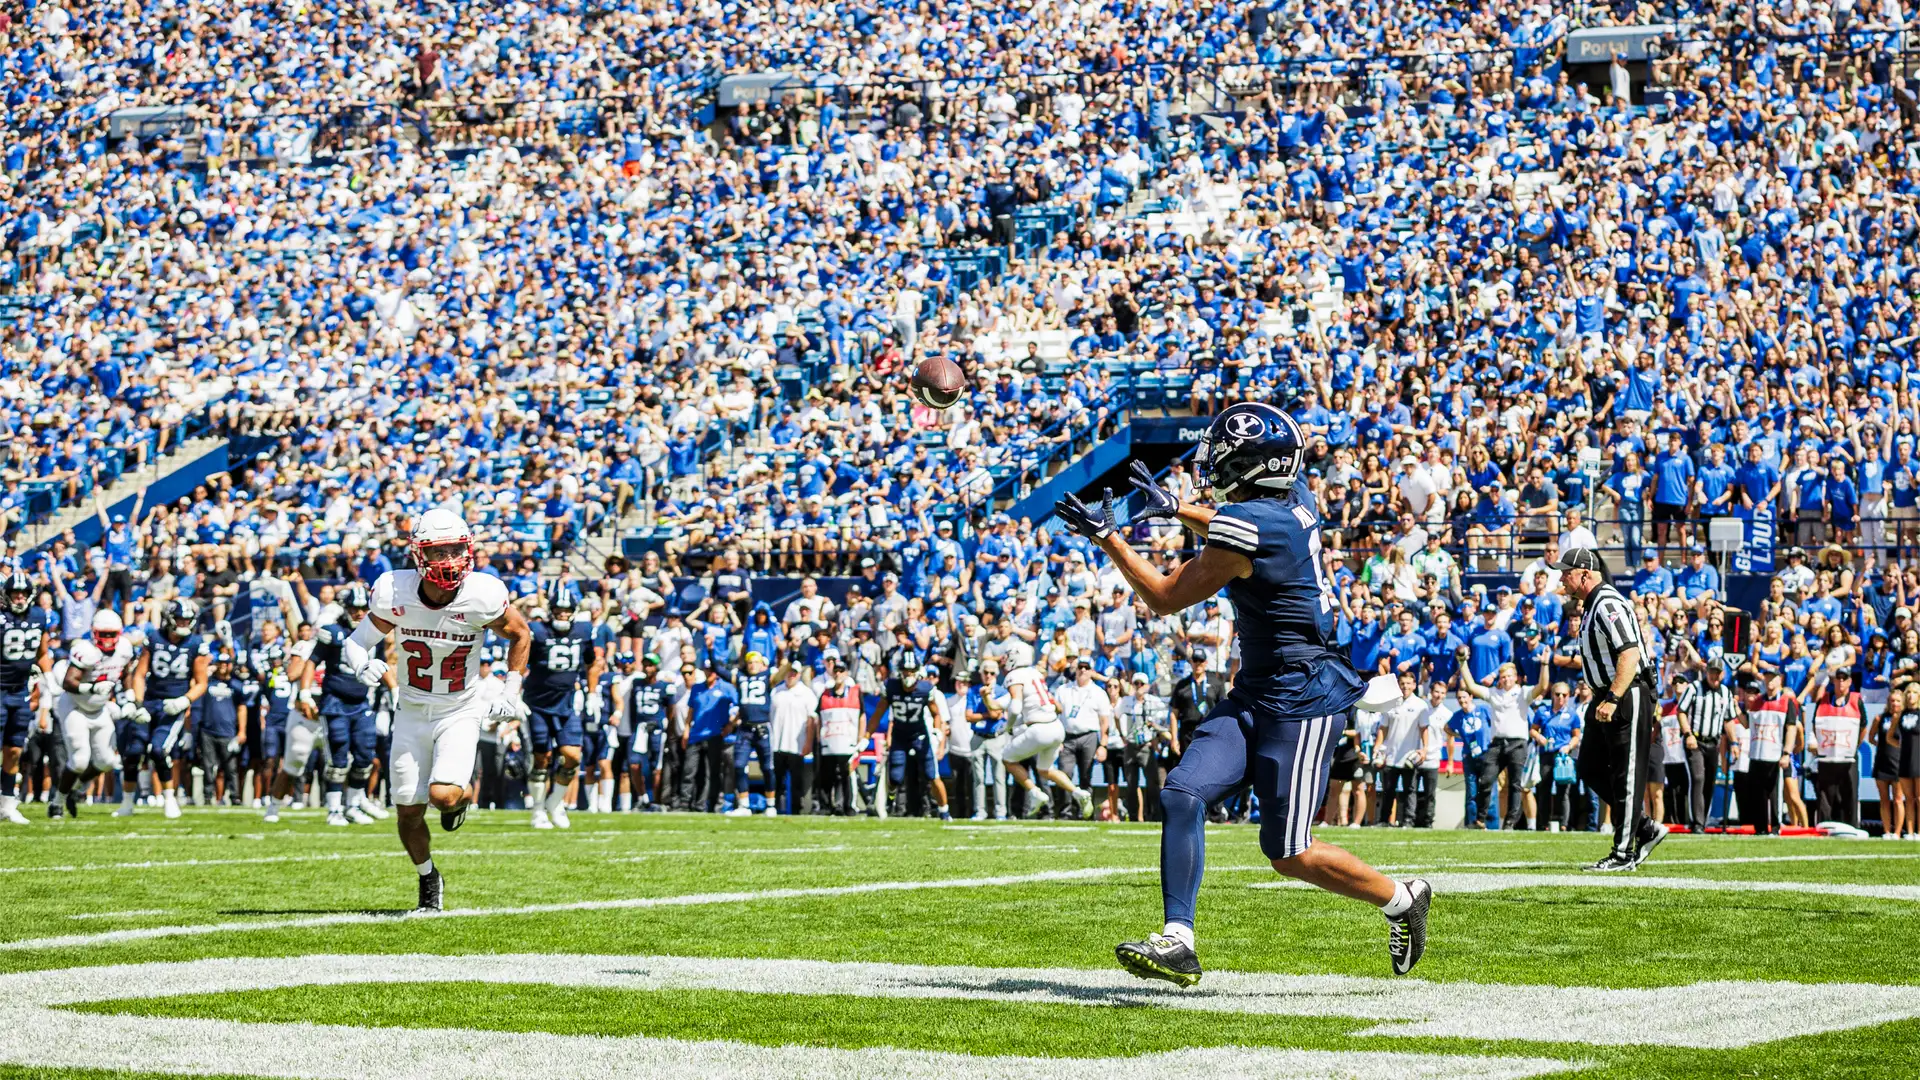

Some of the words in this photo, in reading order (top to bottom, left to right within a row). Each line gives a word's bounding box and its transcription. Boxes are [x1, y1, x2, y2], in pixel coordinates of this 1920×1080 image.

[1232, 415, 1260, 436] Y
[1752, 508, 1773, 564] LOUD
[3, 629, 42, 660] 83
[401, 628, 447, 640] SOUTHERN
[152, 650, 190, 679] 64
[401, 639, 473, 693] 24
[548, 645, 580, 671] 61
[636, 691, 660, 715] 15
[740, 681, 766, 705] 12
[892, 702, 923, 723] 27
